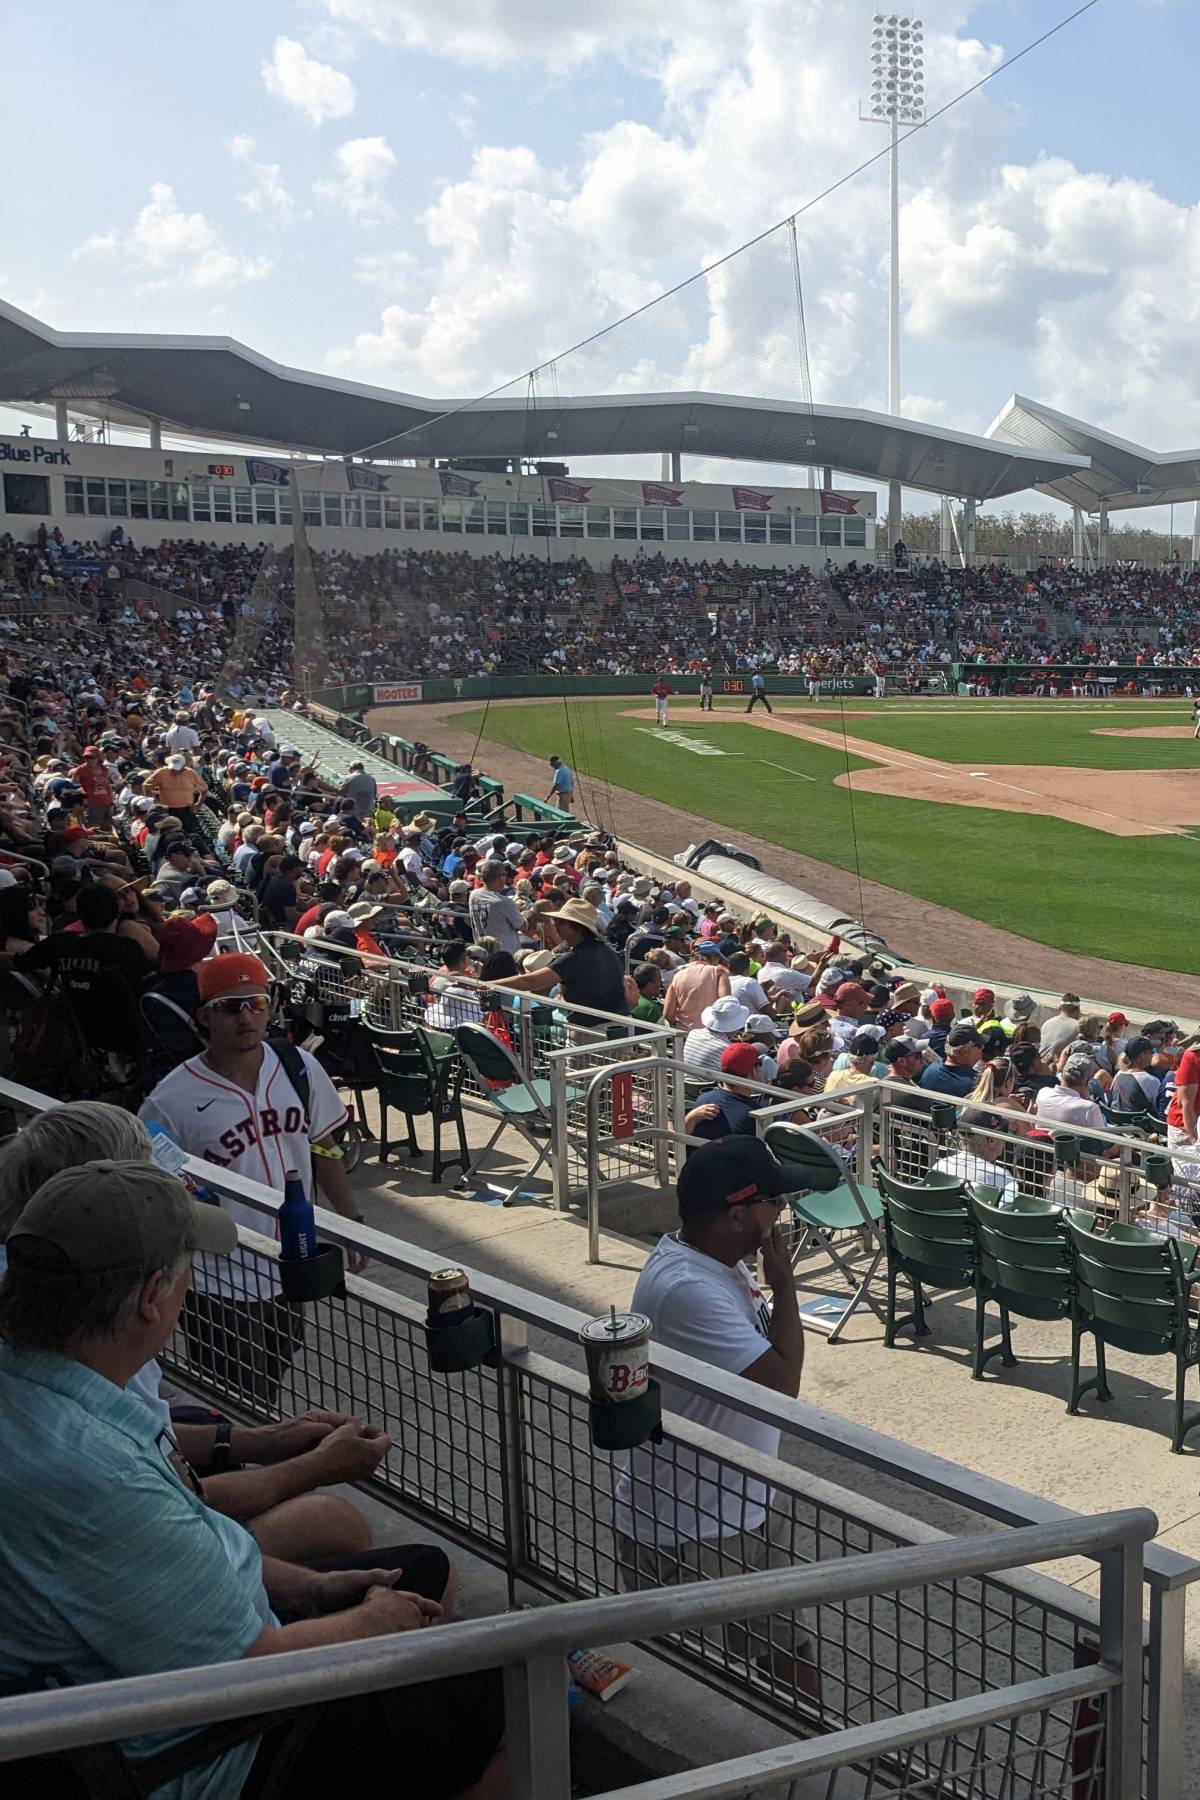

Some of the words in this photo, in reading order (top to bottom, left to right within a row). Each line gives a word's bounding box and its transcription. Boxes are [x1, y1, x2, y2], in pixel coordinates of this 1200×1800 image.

[0, 443, 31, 462] Blue
[33, 446, 71, 465] Park
[376, 687, 418, 700] HOOTERS
[617, 1082, 628, 1126] 115
[299, 1232, 308, 1259] LIGHT
[1189, 1341, 1197, 1356] 12
[608, 1364, 631, 1393] B
